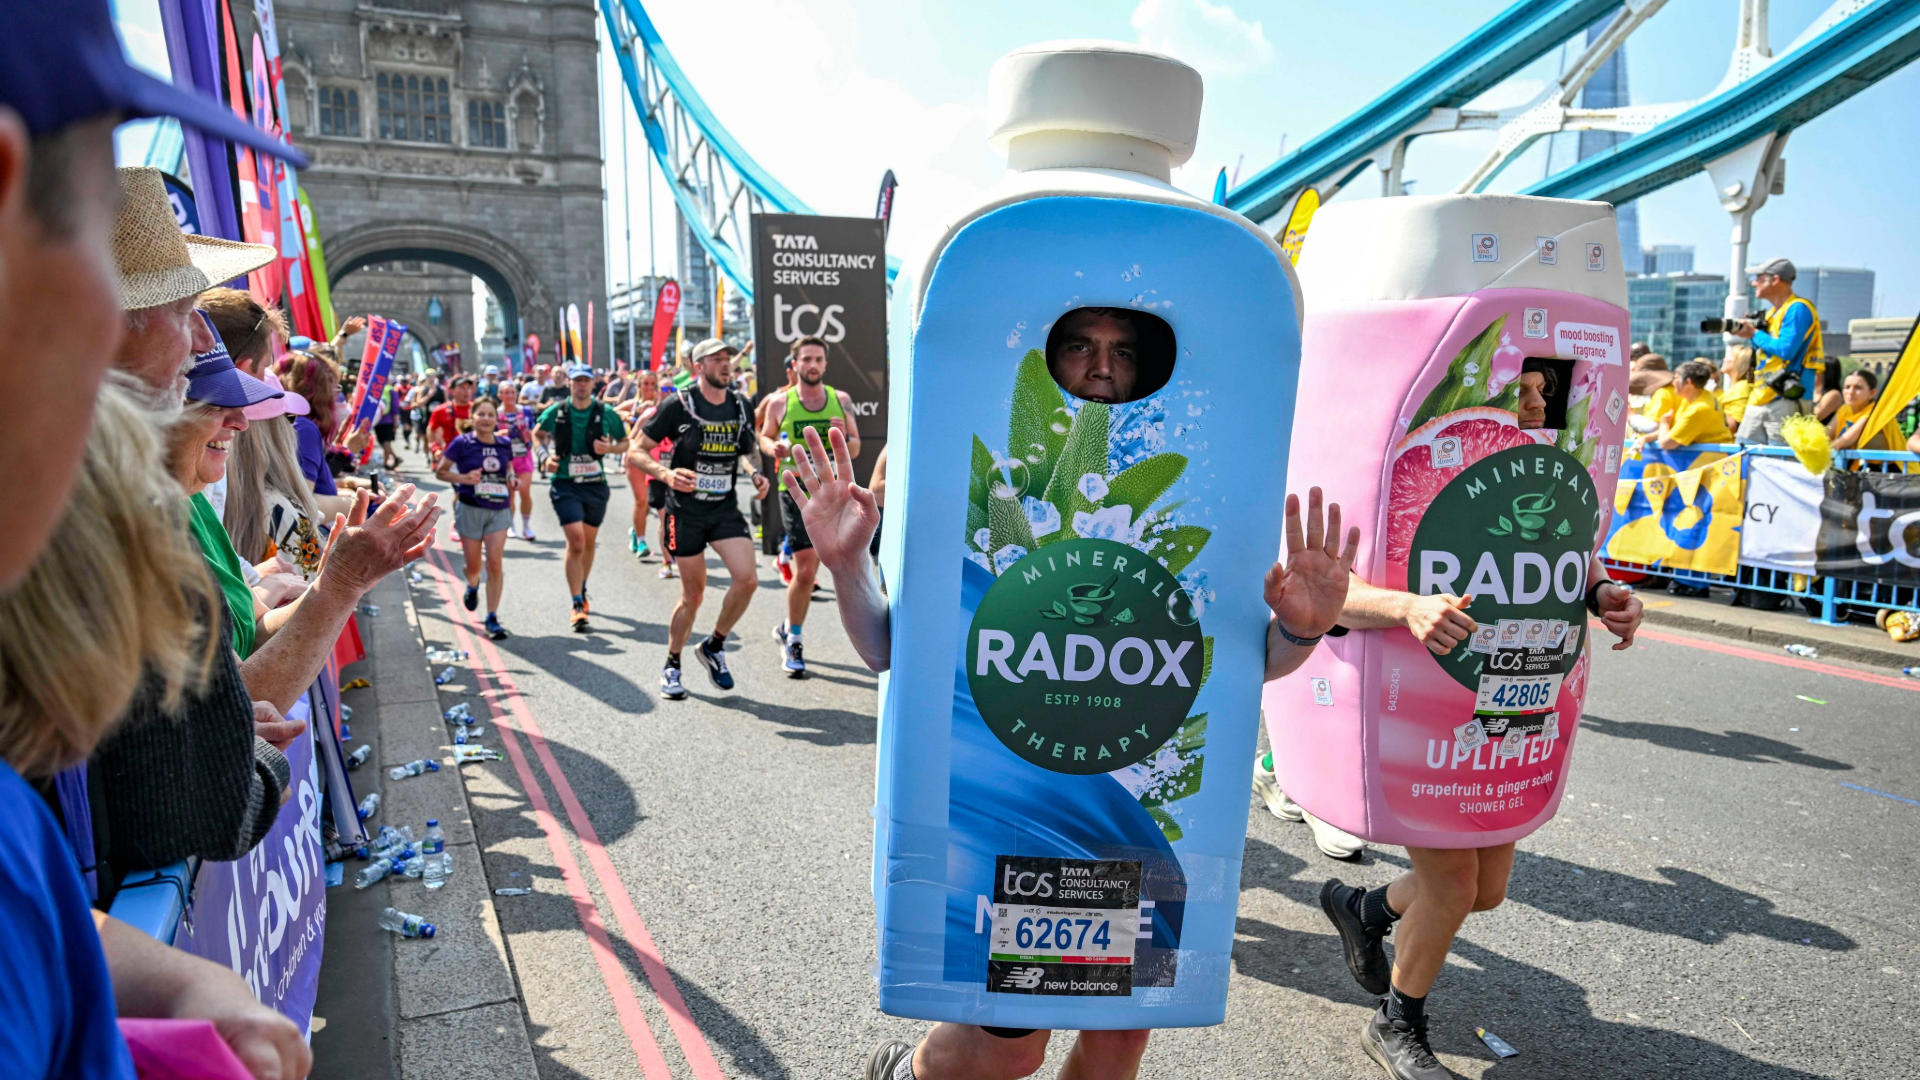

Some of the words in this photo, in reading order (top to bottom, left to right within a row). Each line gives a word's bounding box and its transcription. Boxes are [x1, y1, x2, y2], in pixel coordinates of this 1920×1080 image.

[772, 234, 818, 250] TATA
[772, 252, 876, 269] CONSULTANCY
[773, 270, 840, 285] SERVICES
[774, 294, 846, 343] tcs
[384, 329, 401, 354] PSP
[1560, 329, 1582, 340] mood
[1584, 330, 1613, 346] boosting
[1573, 344, 1606, 358] fragrance
[371, 374, 386, 399] PSP
[482, 448, 498, 456] ITA
[1466, 458, 1589, 505] MINERAL
[1022, 551, 1166, 598] MINERAL
[976, 628, 1194, 688] RADOX
[1490, 652, 1523, 670] tcs
[1526, 654, 1563, 662] CONSULTANCY
[1388, 668, 1401, 711] 64352434
[1492, 683, 1551, 707] 42805
[1087, 696, 1122, 708] 1908
[1011, 718, 1150, 761] THERAPY
[1411, 782, 1481, 798] grapefruit
[1485, 784, 1493, 795] &
[1497, 779, 1529, 797] ginger
[1532, 771, 1553, 787] scent
[1459, 800, 1505, 814] SHOWER
[1509, 799, 1524, 808] GEL
[1004, 864, 1053, 898] tcs
[1061, 867, 1090, 877] TATA
[1059, 878, 1130, 889] CONSULTANCY
[1058, 890, 1104, 900] SERVICES
[1016, 917, 1111, 950] 62674
[277, 932, 307, 1000] children
[306, 916, 316, 942] &
[1044, 981, 1068, 990] new
[1070, 979, 1118, 991] balance
